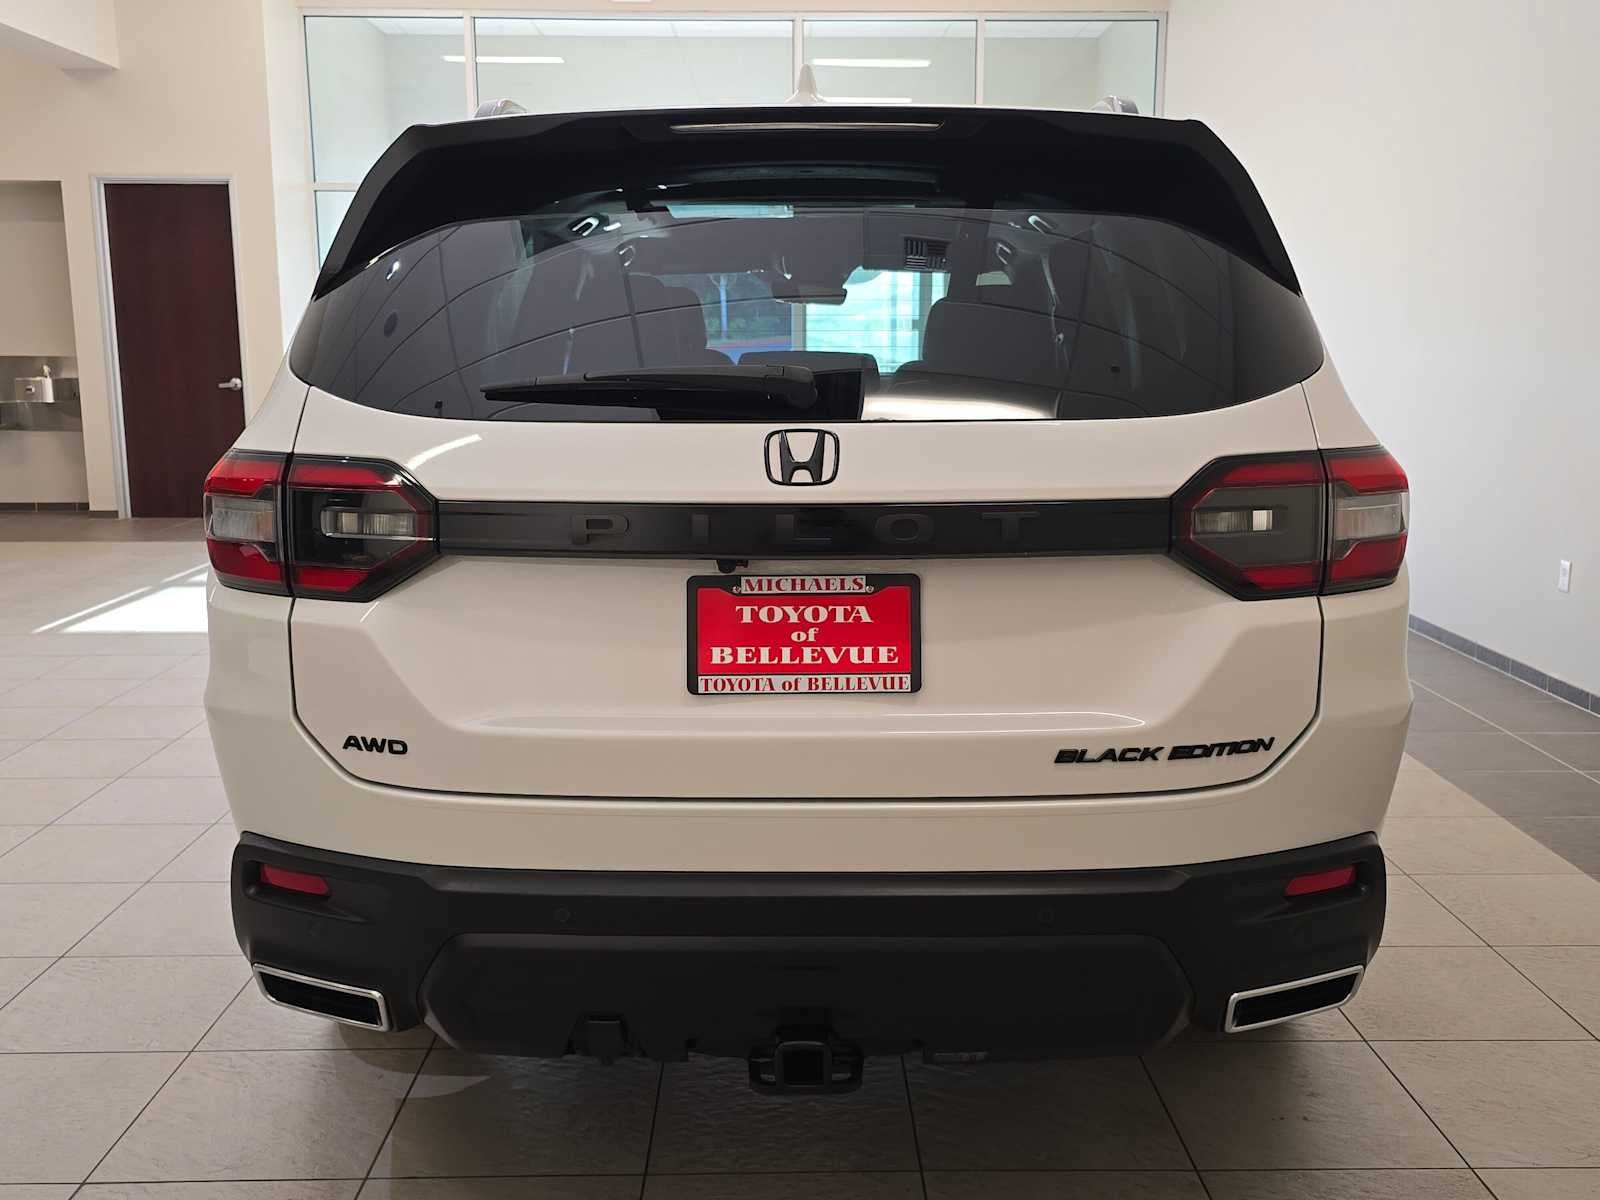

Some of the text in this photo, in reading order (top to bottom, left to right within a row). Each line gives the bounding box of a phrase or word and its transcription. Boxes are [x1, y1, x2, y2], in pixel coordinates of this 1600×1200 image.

[573, 511, 1039, 545] PILOT
[744, 577, 865, 592] MICHAELS
[736, 605, 873, 623] TOYOTA
[791, 627, 819, 642] of
[710, 646, 899, 664] BELLEVUE
[700, 676, 909, 692] TOYOTA of BELLEVUE
[342, 735, 408, 755] AWD
[1054, 737, 1275, 763] BLACK EDITION
